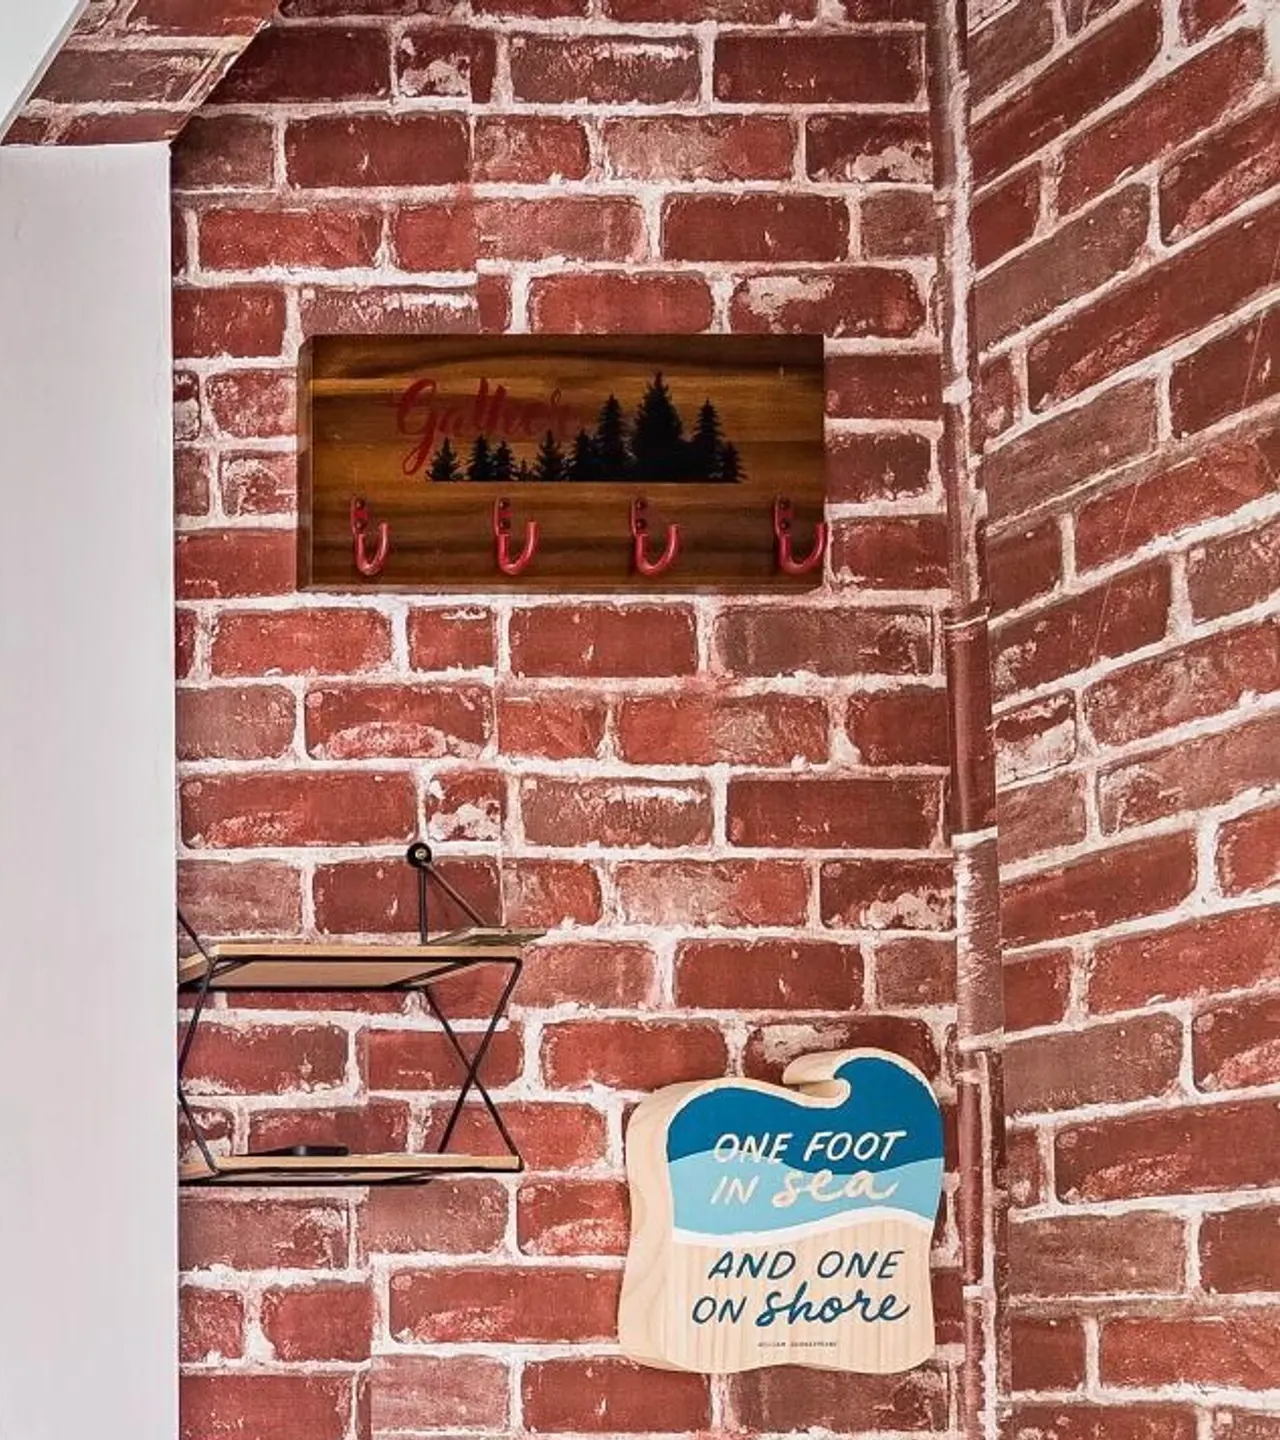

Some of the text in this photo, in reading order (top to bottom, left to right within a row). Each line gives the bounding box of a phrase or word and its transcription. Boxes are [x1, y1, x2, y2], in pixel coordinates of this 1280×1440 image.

[713, 1131, 907, 1164] ONE FOOT
[710, 1169, 899, 1208] IN sea
[707, 1250, 905, 1280] AND ONE
[691, 1281, 911, 1327] ON shore
